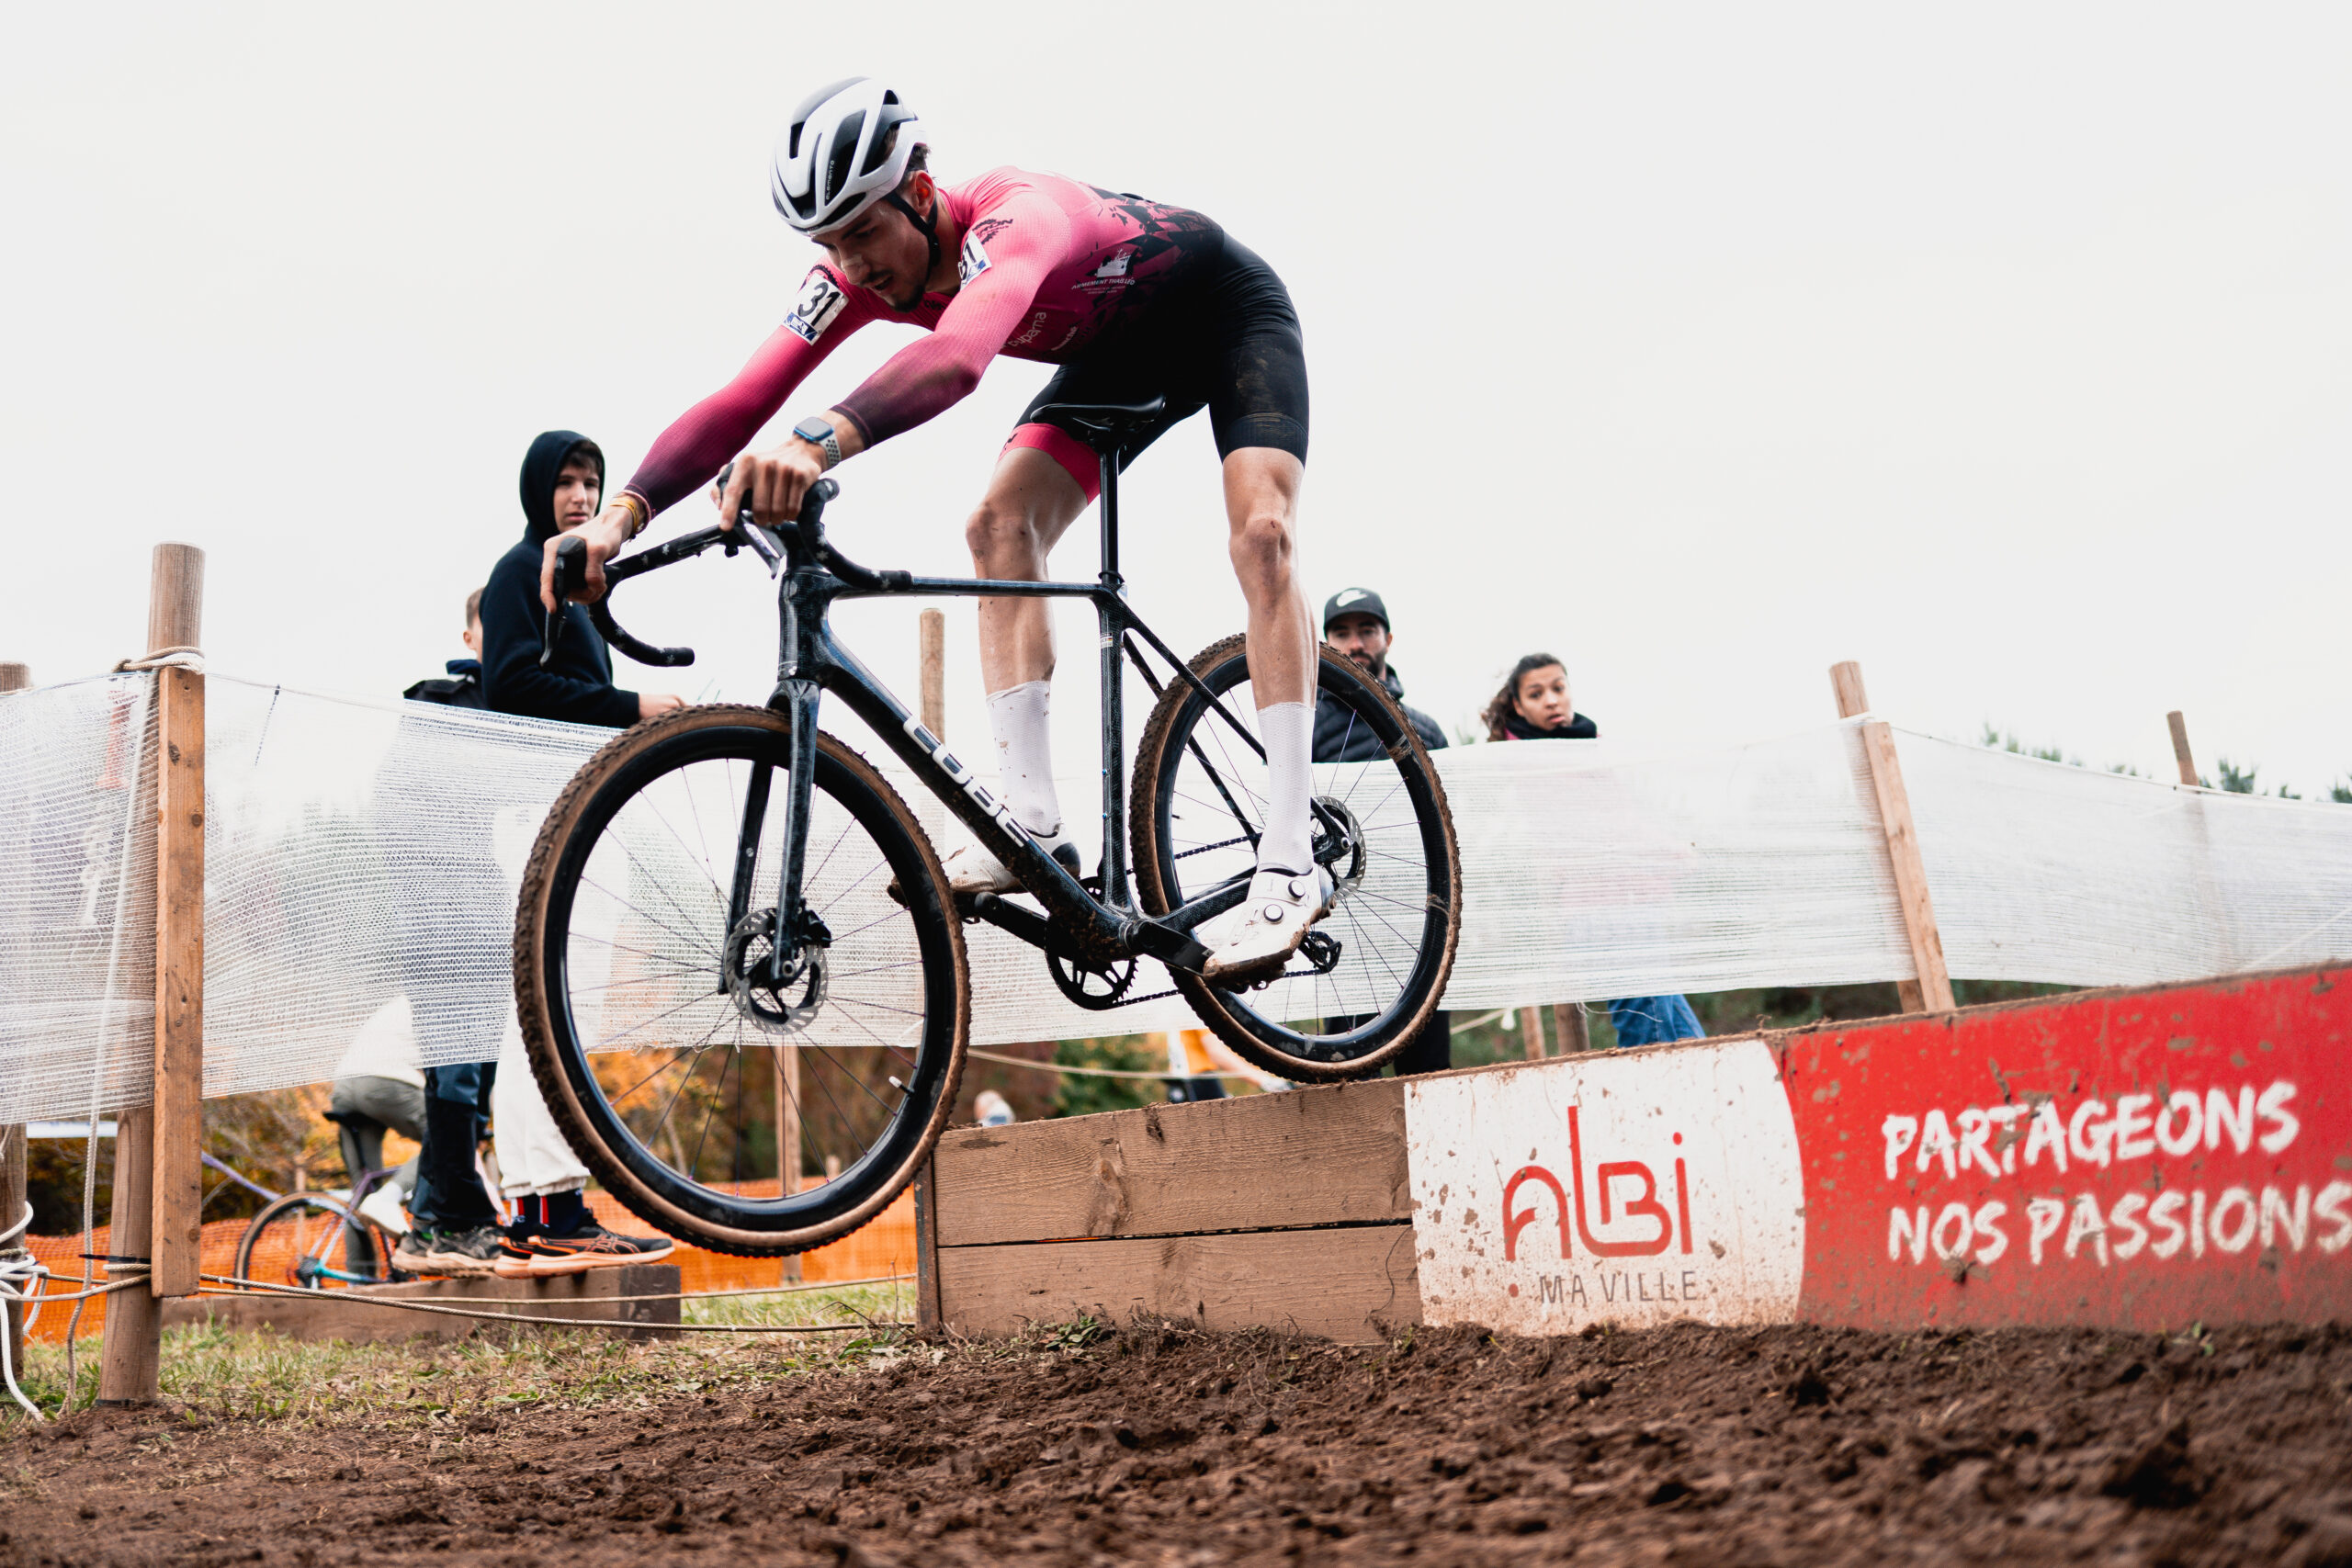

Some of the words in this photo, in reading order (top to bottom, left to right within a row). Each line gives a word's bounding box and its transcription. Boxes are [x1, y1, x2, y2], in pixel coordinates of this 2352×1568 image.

[797, 282, 841, 327] 31
[903, 715, 1029, 848] CUBE
[1881, 1080, 2301, 1180] PARTAGEONS
[1888, 1200, 2009, 1266] NOS
[2027, 1180, 2352, 1267] PASSIONS
[1539, 1274, 1588, 1304] MA
[1600, 1270, 1698, 1303] VILLE
